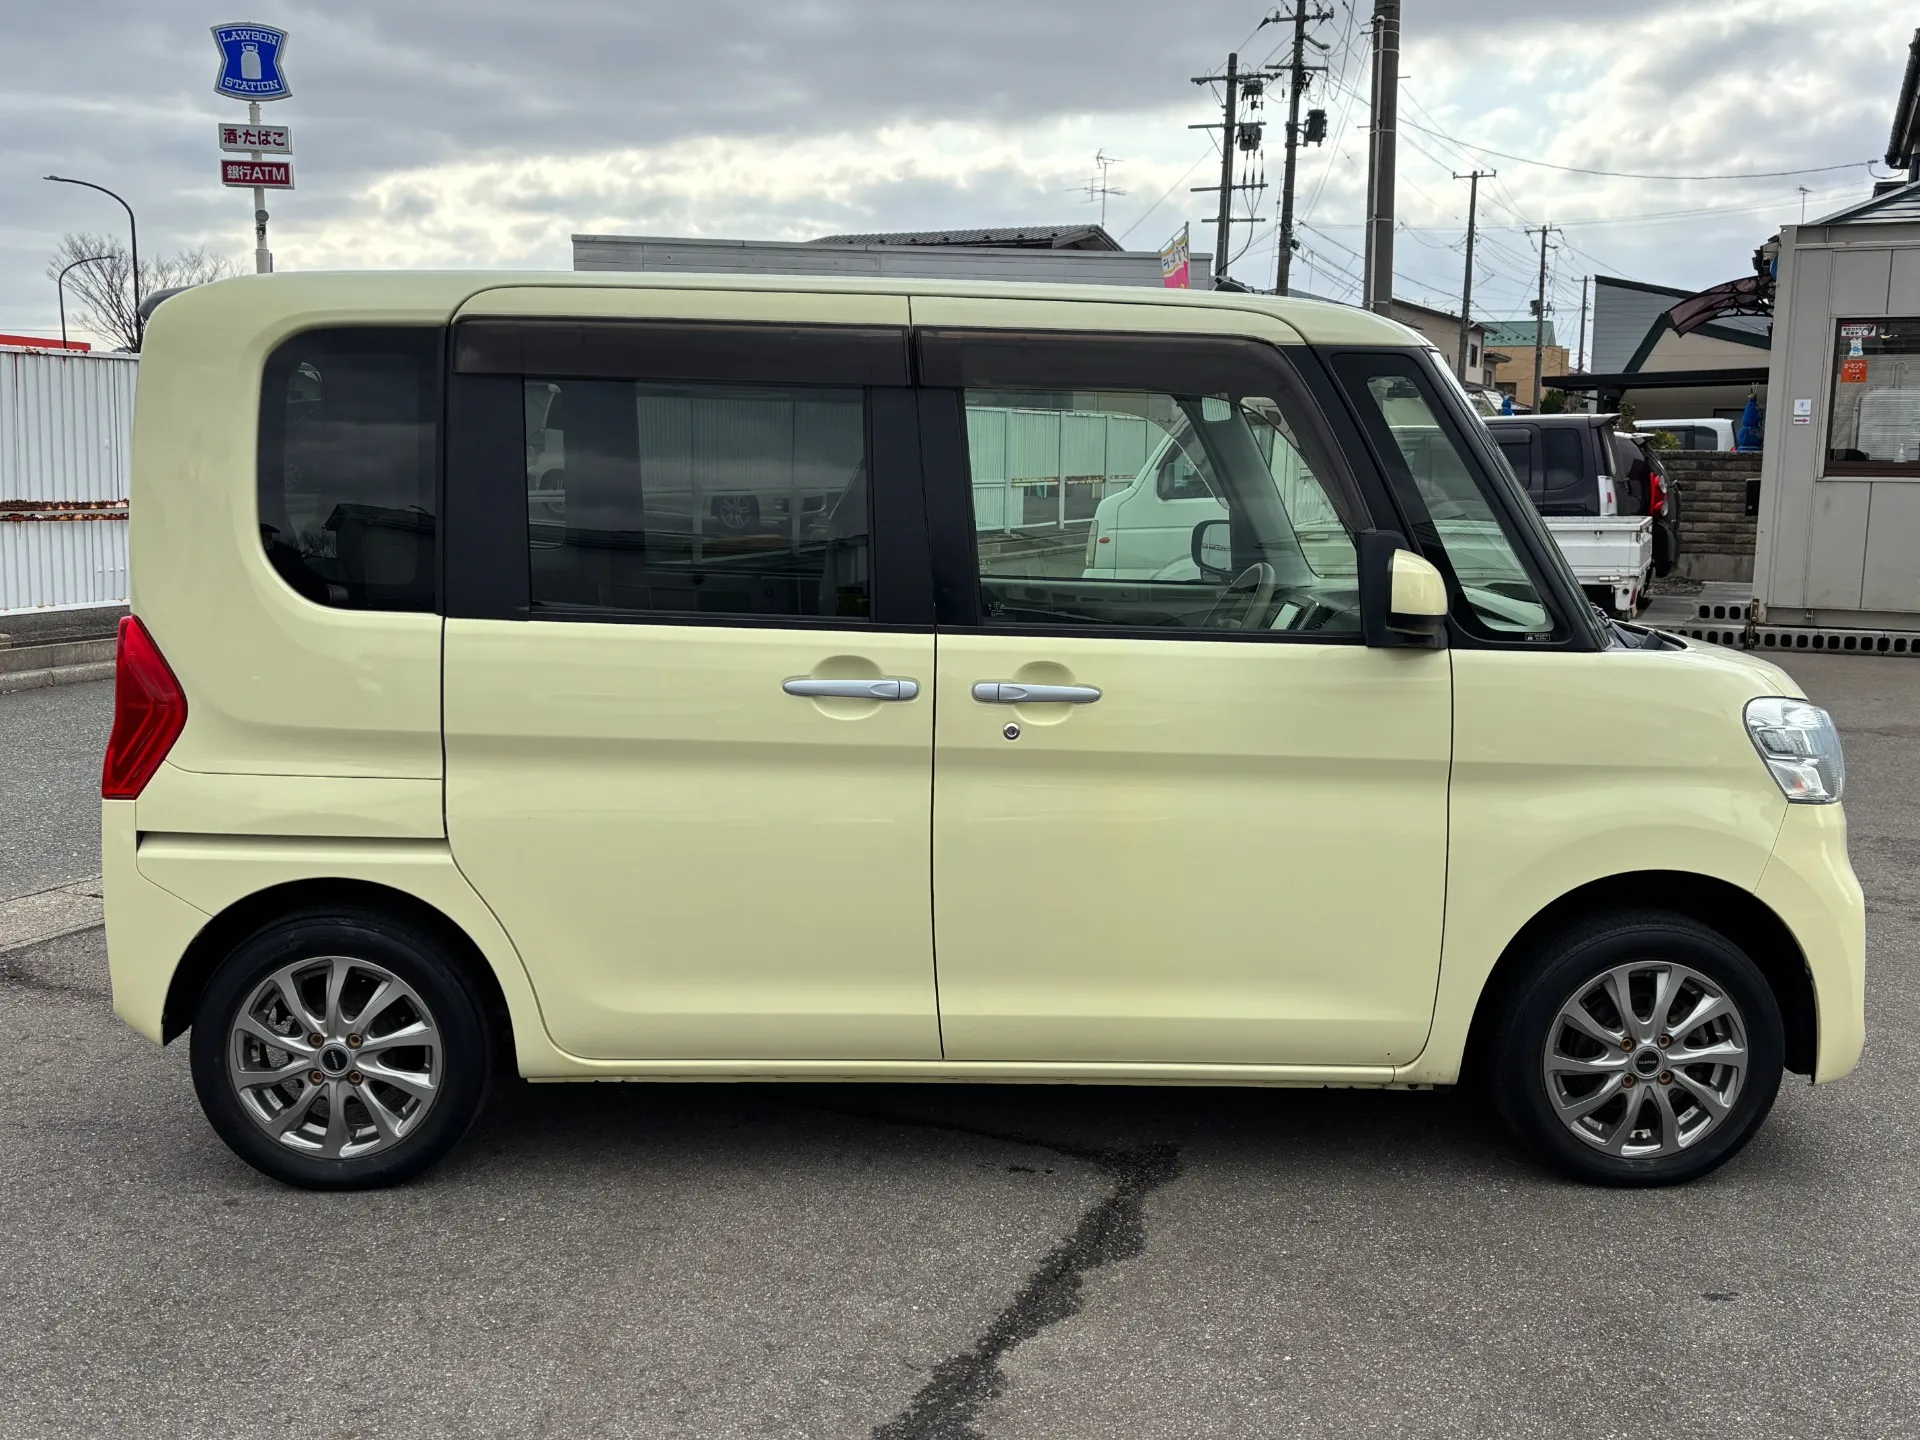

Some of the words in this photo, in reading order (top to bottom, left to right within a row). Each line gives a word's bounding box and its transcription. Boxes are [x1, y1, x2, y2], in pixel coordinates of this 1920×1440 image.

[220, 30, 278, 46] LAWSON
[224, 76, 280, 91] STATION
[223, 128, 285, 147] 酒・たばこ
[226, 164, 286, 181] 銀行ATM
